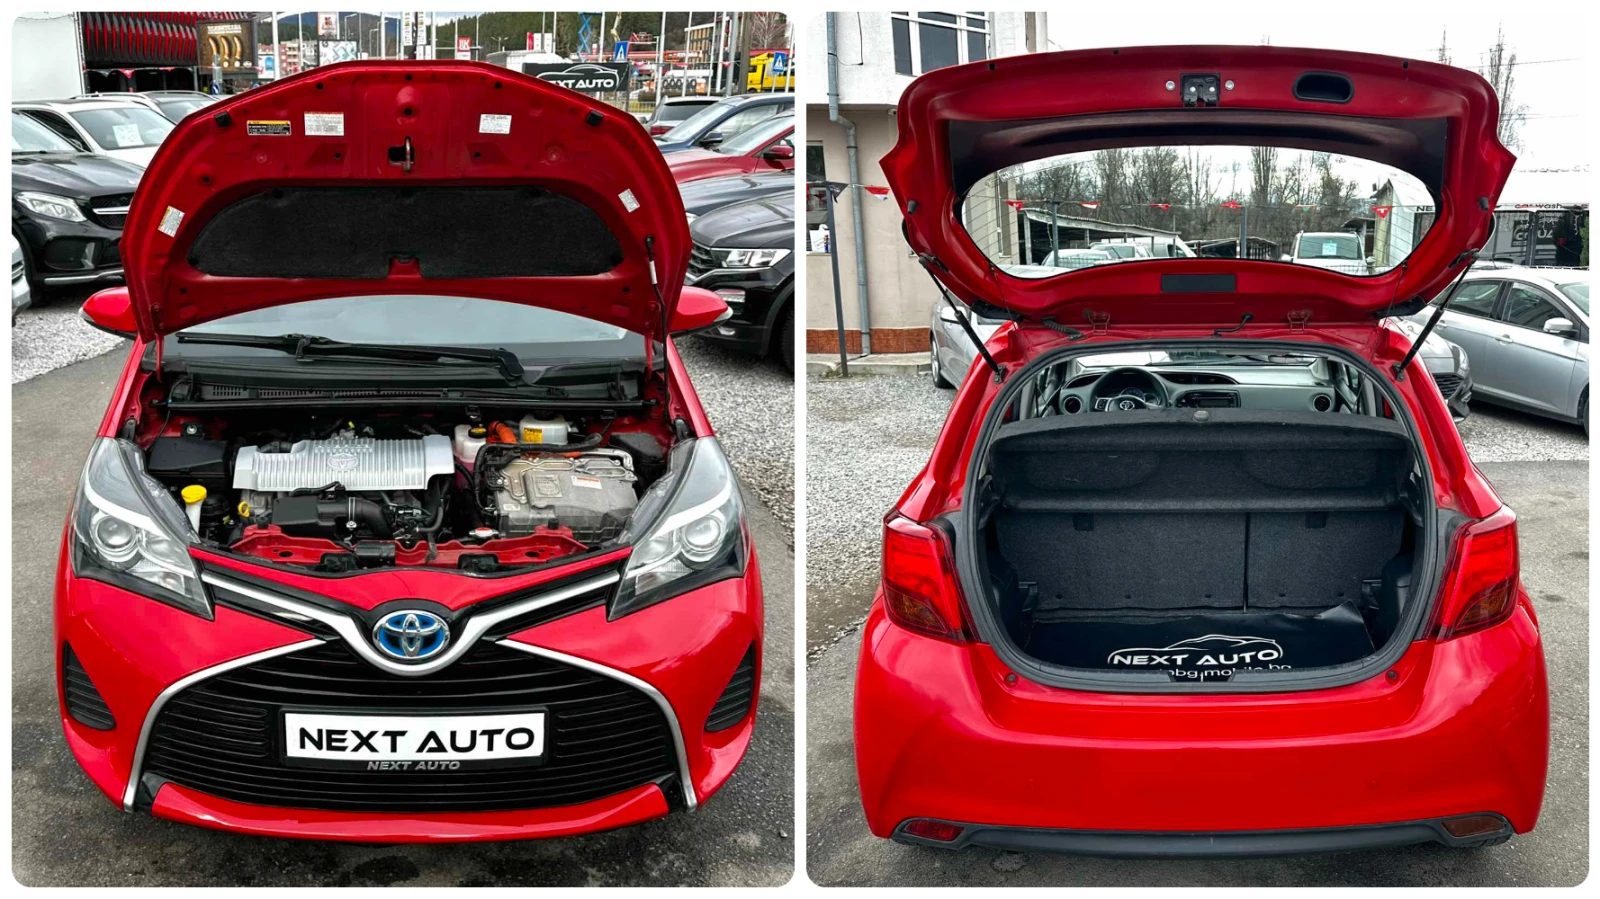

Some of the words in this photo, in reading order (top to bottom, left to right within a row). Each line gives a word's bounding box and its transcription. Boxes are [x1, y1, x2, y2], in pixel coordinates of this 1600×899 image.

[575, 78, 614, 89] AUTO
[1113, 654, 1190, 666] NEXT
[1196, 649, 1279, 666] AUTO
[299, 726, 408, 753] NEXT
[415, 726, 535, 753] AUTO
[367, 761, 412, 771] NEXT
[415, 760, 460, 770] AUTO
